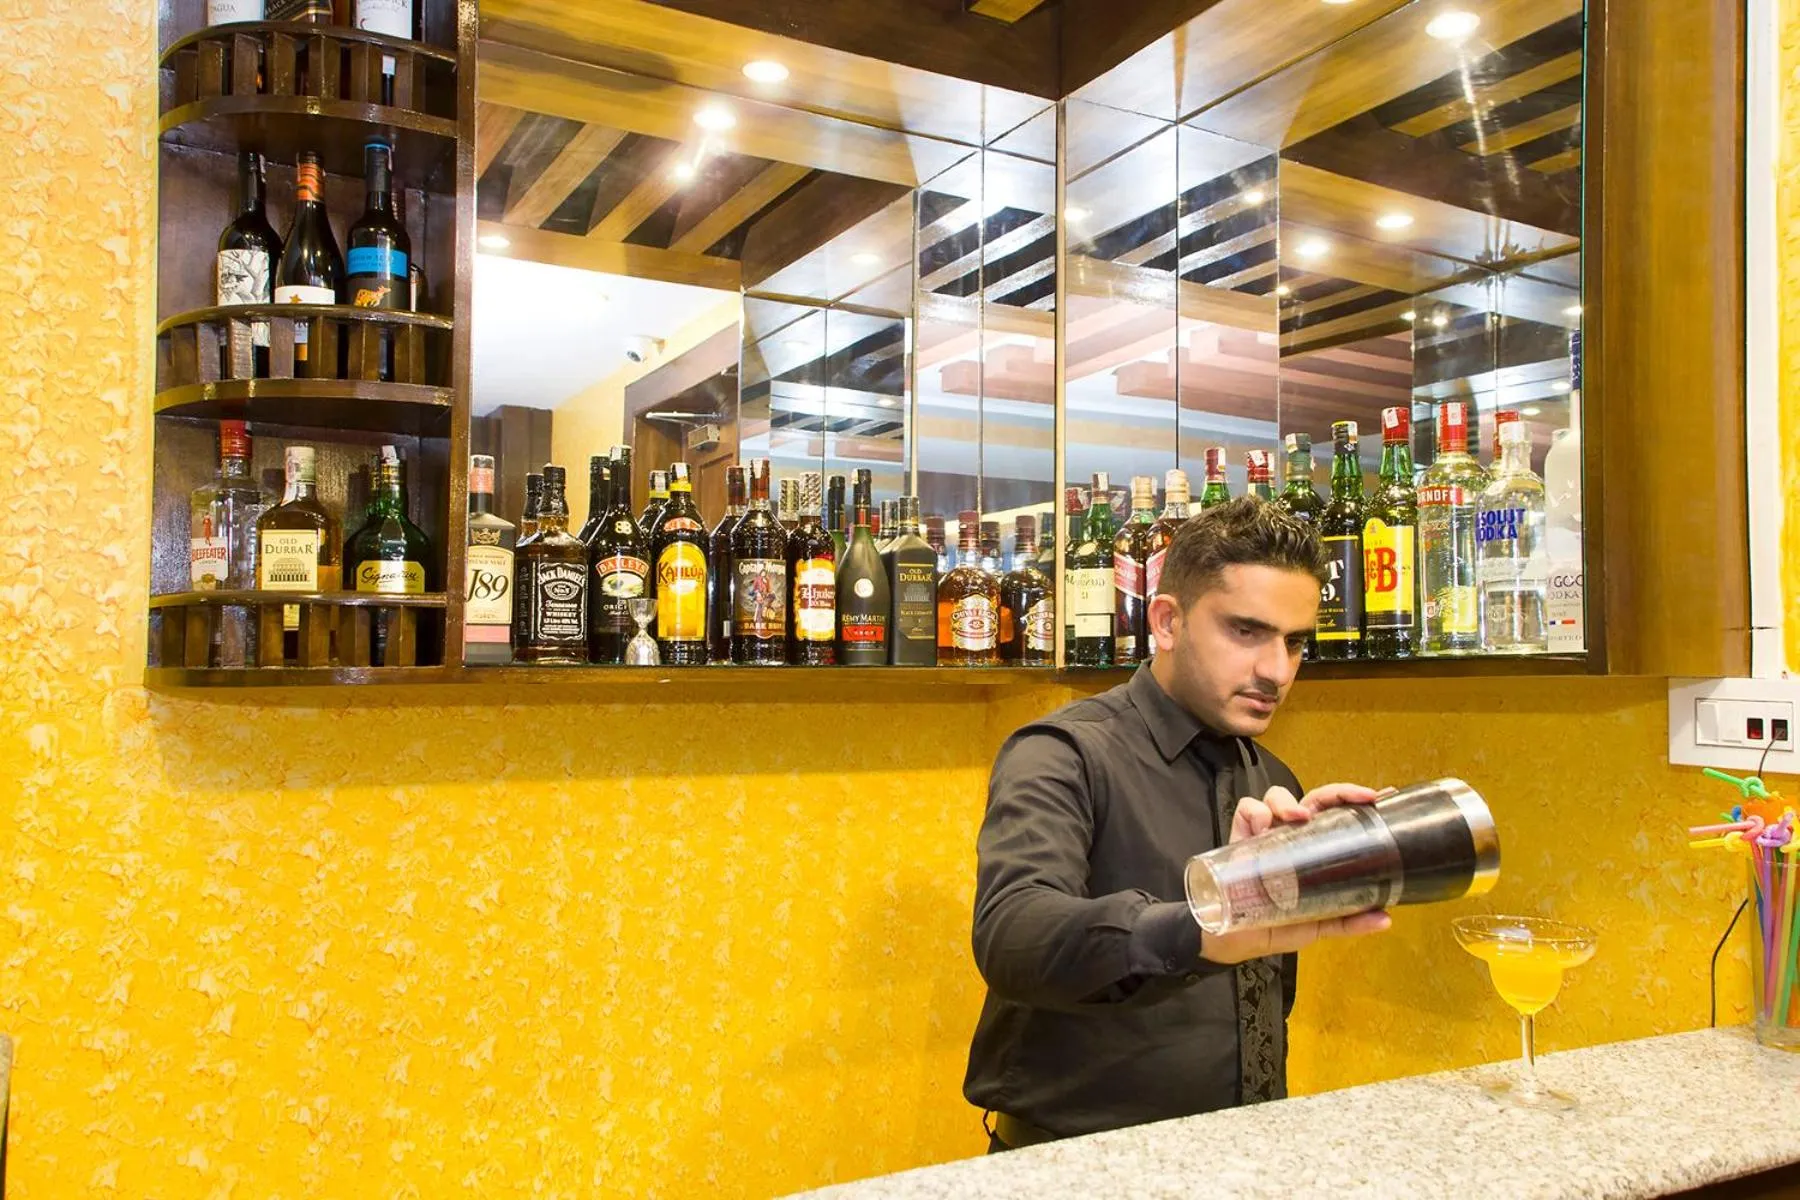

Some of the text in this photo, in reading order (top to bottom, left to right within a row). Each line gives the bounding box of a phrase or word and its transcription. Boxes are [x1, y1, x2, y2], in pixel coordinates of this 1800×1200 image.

[1476, 508, 1525, 527] SOLUT
[1476, 524, 1518, 543] ODKA
[192, 547, 227, 562] BEEFEATER
[265, 544, 313, 555] DURBAR
[361, 567, 420, 585] Signature
[537, 569, 557, 585] JACK
[1363, 547, 1398, 593] J&B
[464, 569, 509, 602] J89
